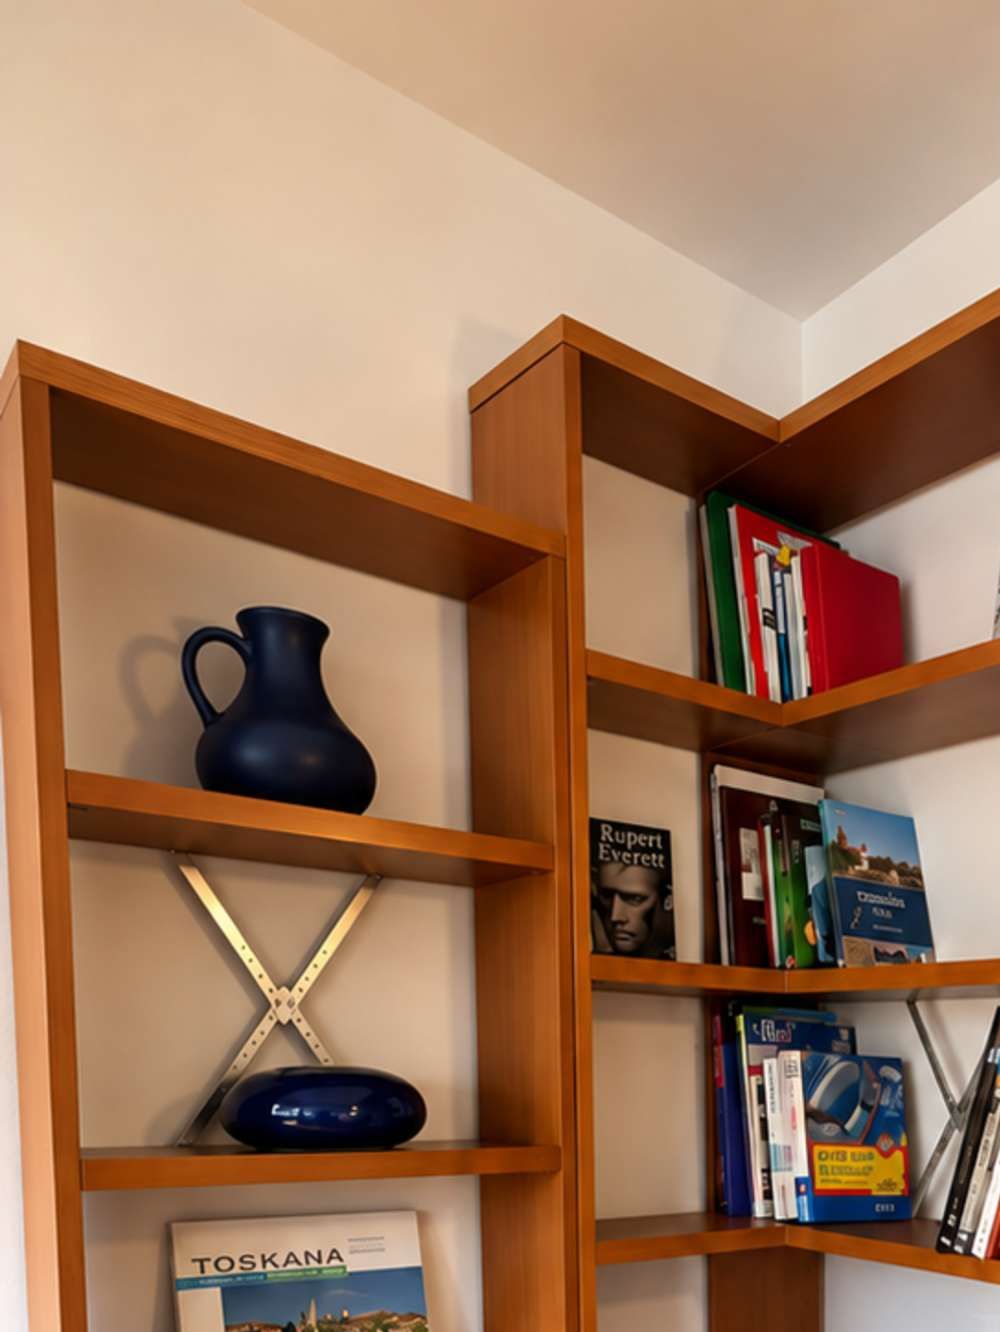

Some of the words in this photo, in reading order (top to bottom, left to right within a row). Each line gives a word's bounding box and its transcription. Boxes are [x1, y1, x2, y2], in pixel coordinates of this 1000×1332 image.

[600, 823, 663, 850] Rupert
[598, 842, 665, 870] Everett
[191, 1247, 344, 1275] TOSKANA
